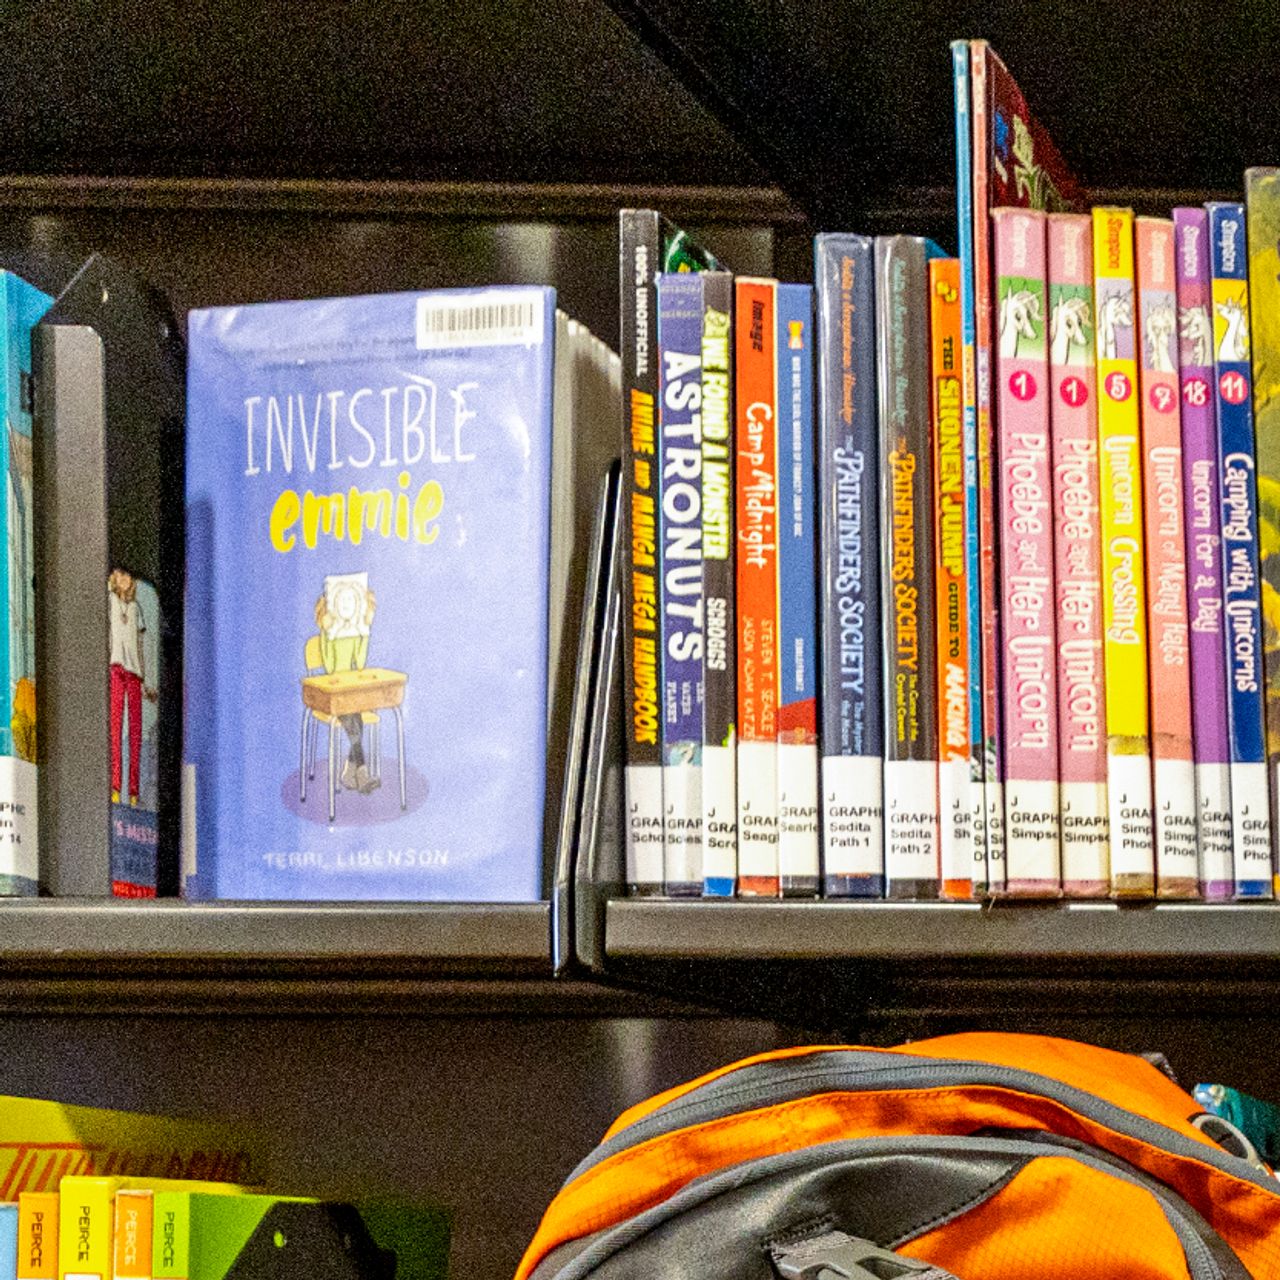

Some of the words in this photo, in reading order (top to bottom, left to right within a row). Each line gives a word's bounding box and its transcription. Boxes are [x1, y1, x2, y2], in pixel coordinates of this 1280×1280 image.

[1107, 218, 1123, 269] Simpson
[1221, 219, 1237, 272] Simpson
[244, 380, 480, 476] INVISIBLE
[630, 389, 653, 453] ANIME
[741, 401, 772, 466] Camp
[938, 379, 961, 492] SHONEN
[270, 471, 444, 552] emmie
[664, 349, 701, 661] ASTRONUTS
[743, 470, 775, 568] Midnight
[836, 450, 863, 592] PATHFINDERS
[1006, 432, 1045, 535] Phoebe
[1192, 460, 1212, 529] Unicorn
[1223, 453, 1253, 539] Camping
[632, 493, 655, 564] MANGA
[941, 500, 961, 575] JUMP
[1017, 540, 1041, 573] and
[1196, 535, 1217, 567] for
[633, 572, 655, 630] MEGA
[1010, 577, 1046, 630] Her
[1232, 549, 1252, 592] with
[840, 599, 864, 694] SOCIETY
[1195, 596, 1221, 632] Day
[1232, 600, 1258, 692] Unicorns
[634, 638, 657, 743] HANDBOOK
[945, 664, 965, 744] MAKING
[1010, 635, 1049, 749] Unicorn
[336, 849, 449, 868] LIBENSON
